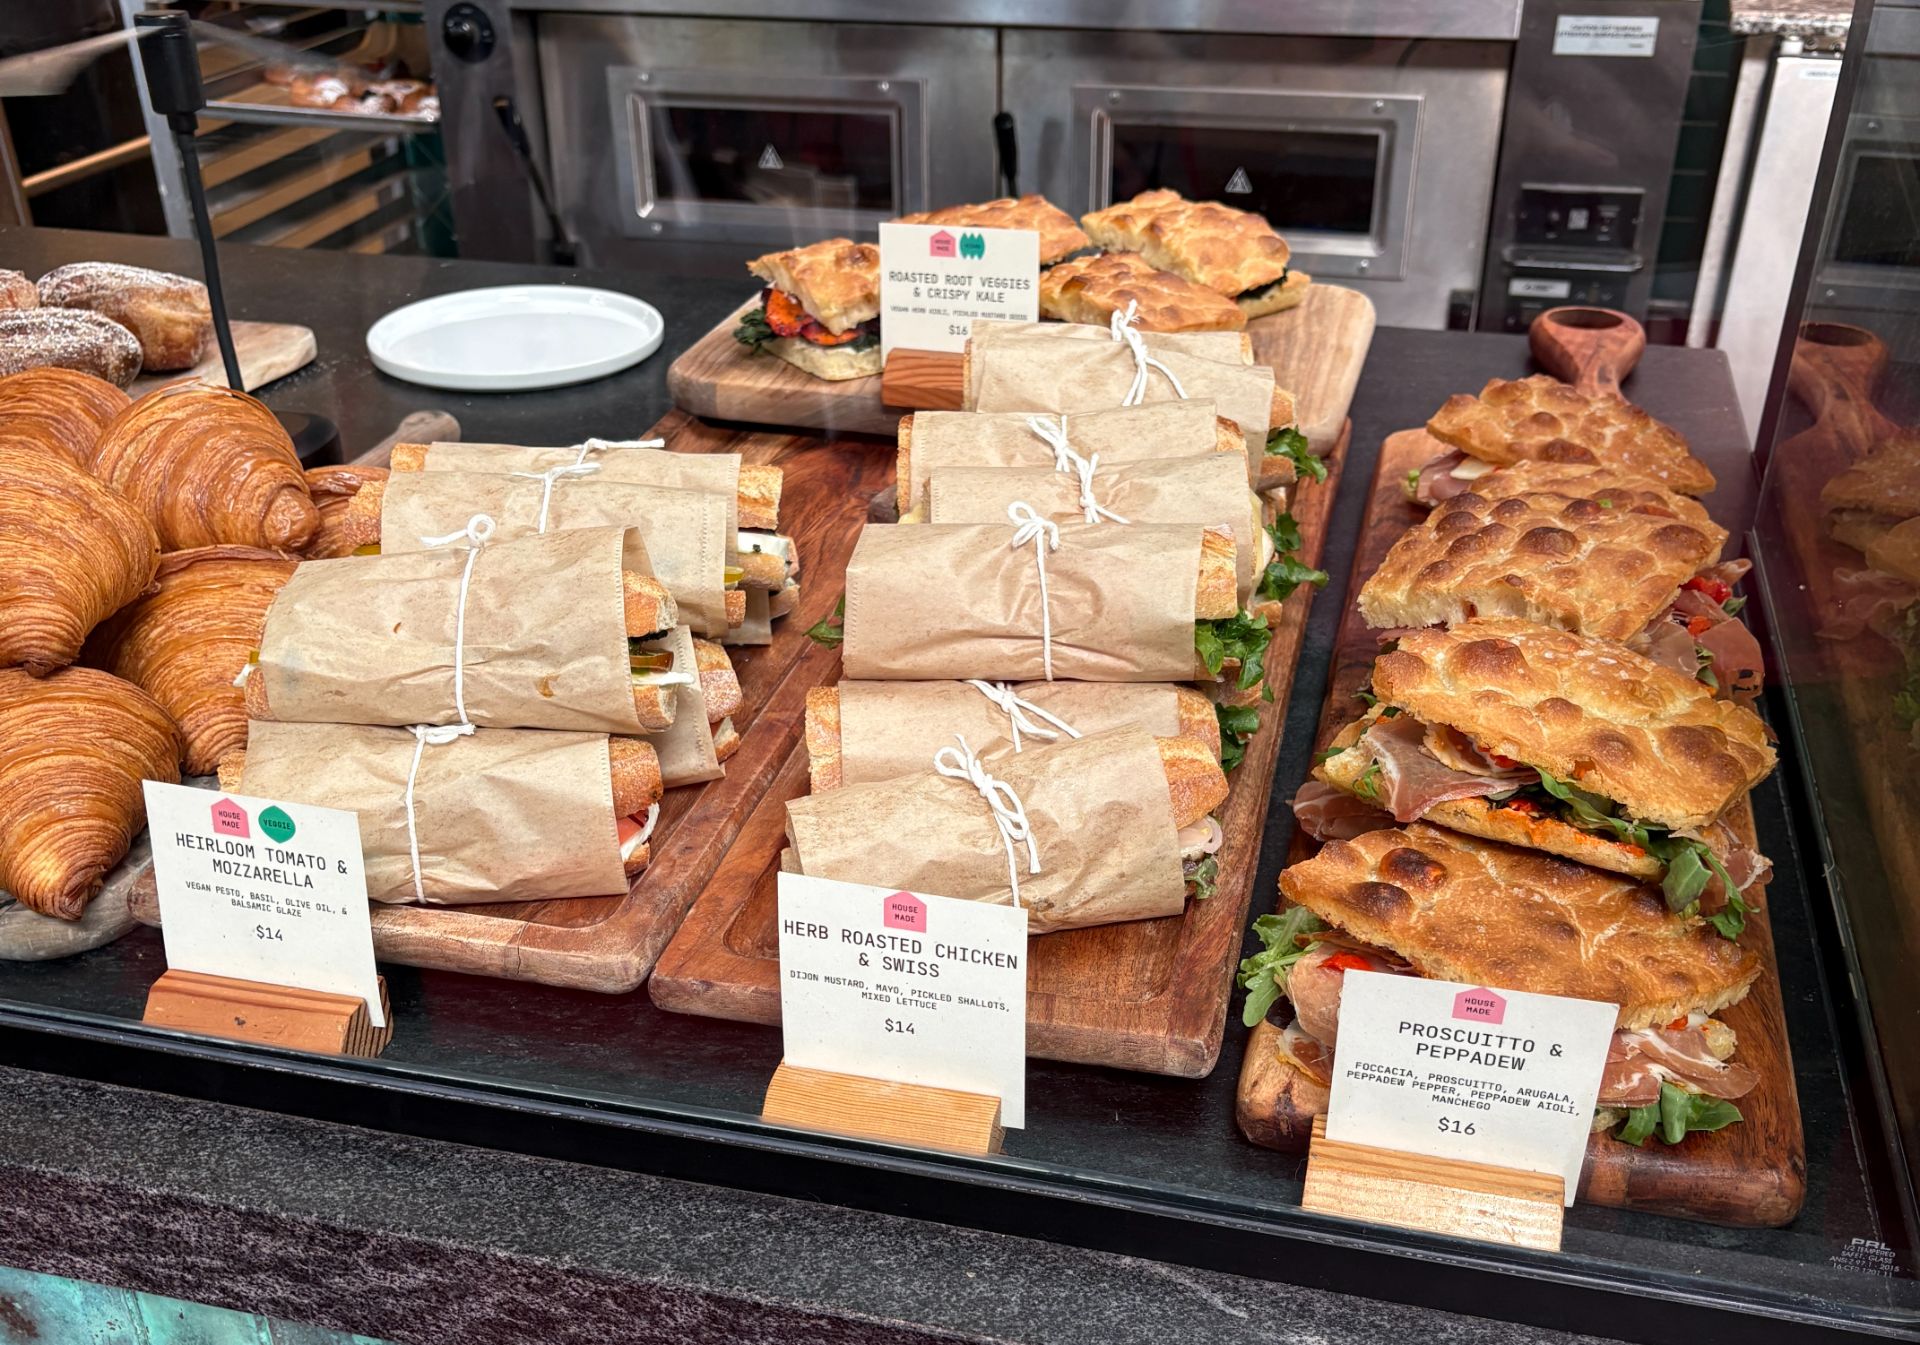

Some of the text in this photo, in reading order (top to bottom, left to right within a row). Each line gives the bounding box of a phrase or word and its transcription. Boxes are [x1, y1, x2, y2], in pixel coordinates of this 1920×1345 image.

[888, 271, 1031, 290] ROASTED ROOT VEGGIES
[913, 287, 1005, 303] & CRISPY KALE
[949, 325, 968, 336] $16
[222, 820, 240, 829] MADE
[263, 819, 291, 831] VEGGIE
[176, 833, 348, 875] HEIRLOOM TOMATO &
[213, 858, 314, 889] MOZZARELLA
[186, 881, 211, 892] VEGAN
[216, 886, 244, 899] PESTO,
[250, 892, 279, 905] BASIL,
[286, 898, 311, 910] OLIVE
[316, 903, 336, 914] OIL,
[231, 899, 302, 917] BALSAMIC GLAZE
[892, 903, 918, 914] HOUSE
[894, 913, 915, 923] MADE
[256, 924, 283, 941] $14
[784, 920, 1018, 969] HERB ROASTED CHICKEN
[859, 953, 940, 978] & SWISS
[790, 970, 1010, 1012] DIJON MUSTARD, MAYO, PICKLED SHALLOTS,
[862, 991, 937, 1010] MIXED LETTUCE
[1465, 997, 1496, 1008] HOUSE
[1466, 1006, 1491, 1016] MADE
[885, 1018, 915, 1035] $14
[1399, 1021, 1563, 1058] PROSCUITTO &
[1416, 1042, 1526, 1071] PEPPADEW
[1355, 1061, 1575, 1105] FOCCACIA, PROSCUITTO, ARUGALA,
[1347, 1071, 1580, 1116] PEPPADEW PEPPER, PEPPADEW AIOLI,
[1431, 1094, 1491, 1111] MANCHEGO
[1437, 1117, 1476, 1135] $16
[1851, 1238, 1891, 1251] PRL
